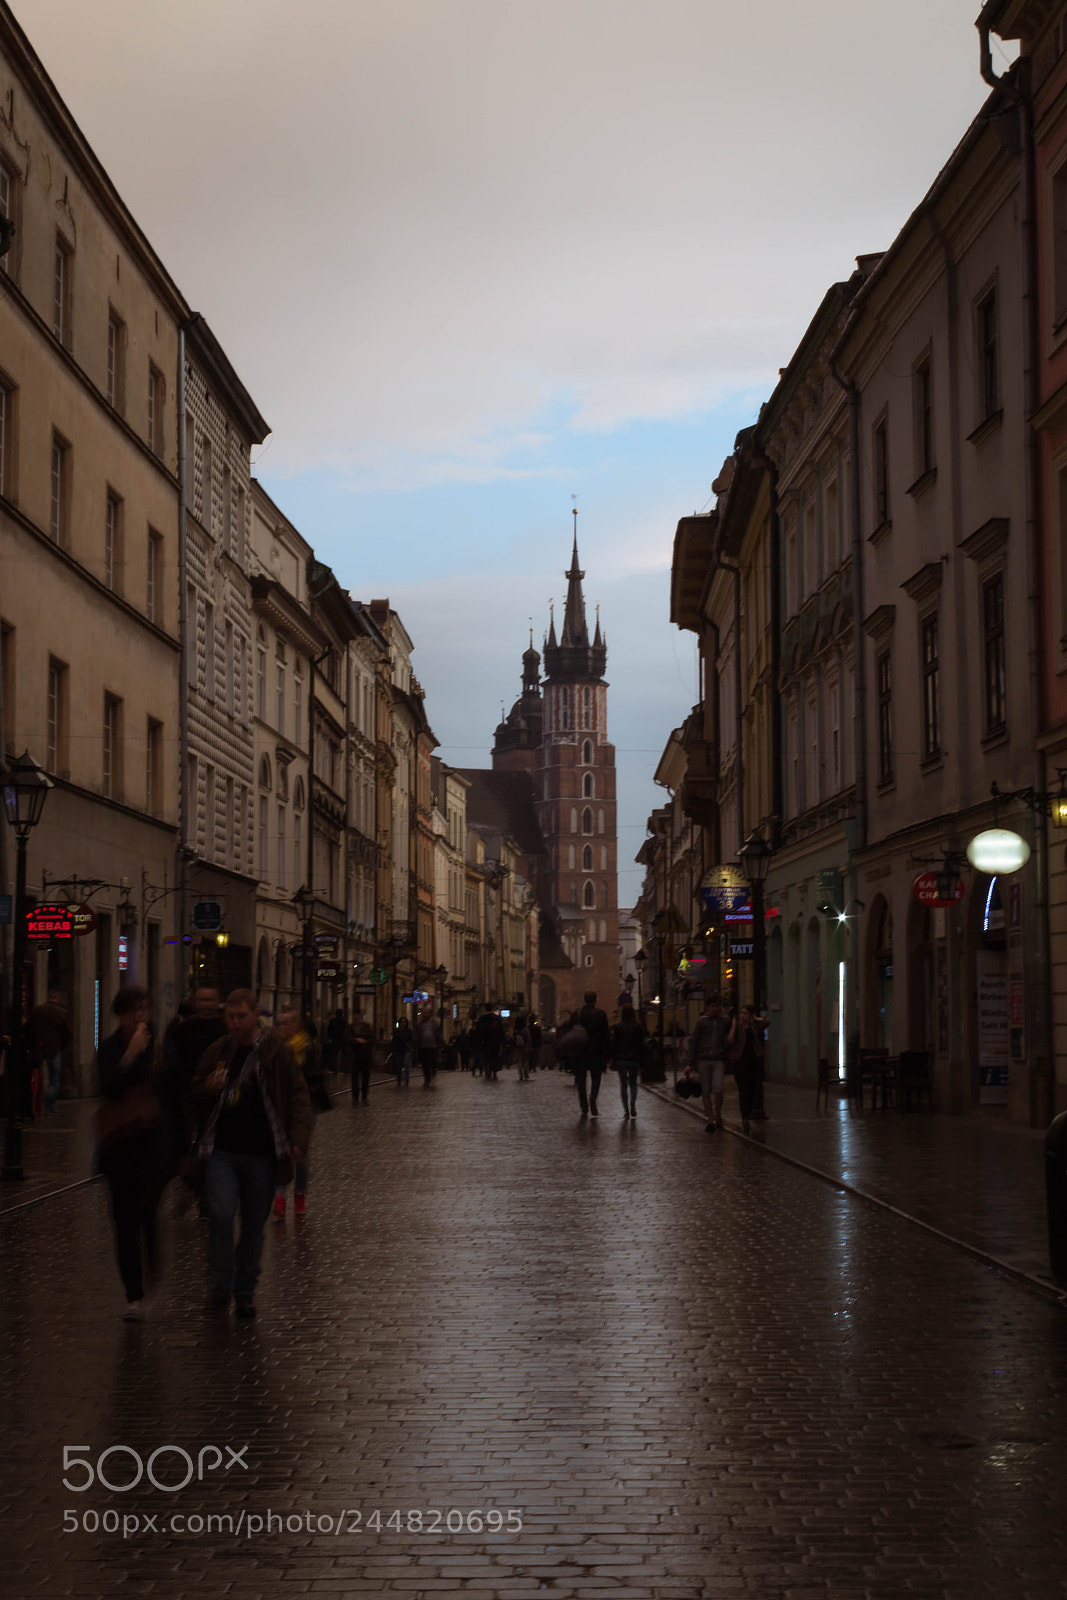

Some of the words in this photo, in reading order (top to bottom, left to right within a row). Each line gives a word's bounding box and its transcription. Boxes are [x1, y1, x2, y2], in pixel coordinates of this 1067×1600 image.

[28, 921, 73, 932] KEBAB
[730, 944, 754, 954] TATT
[317, 968, 337, 977] PUB
